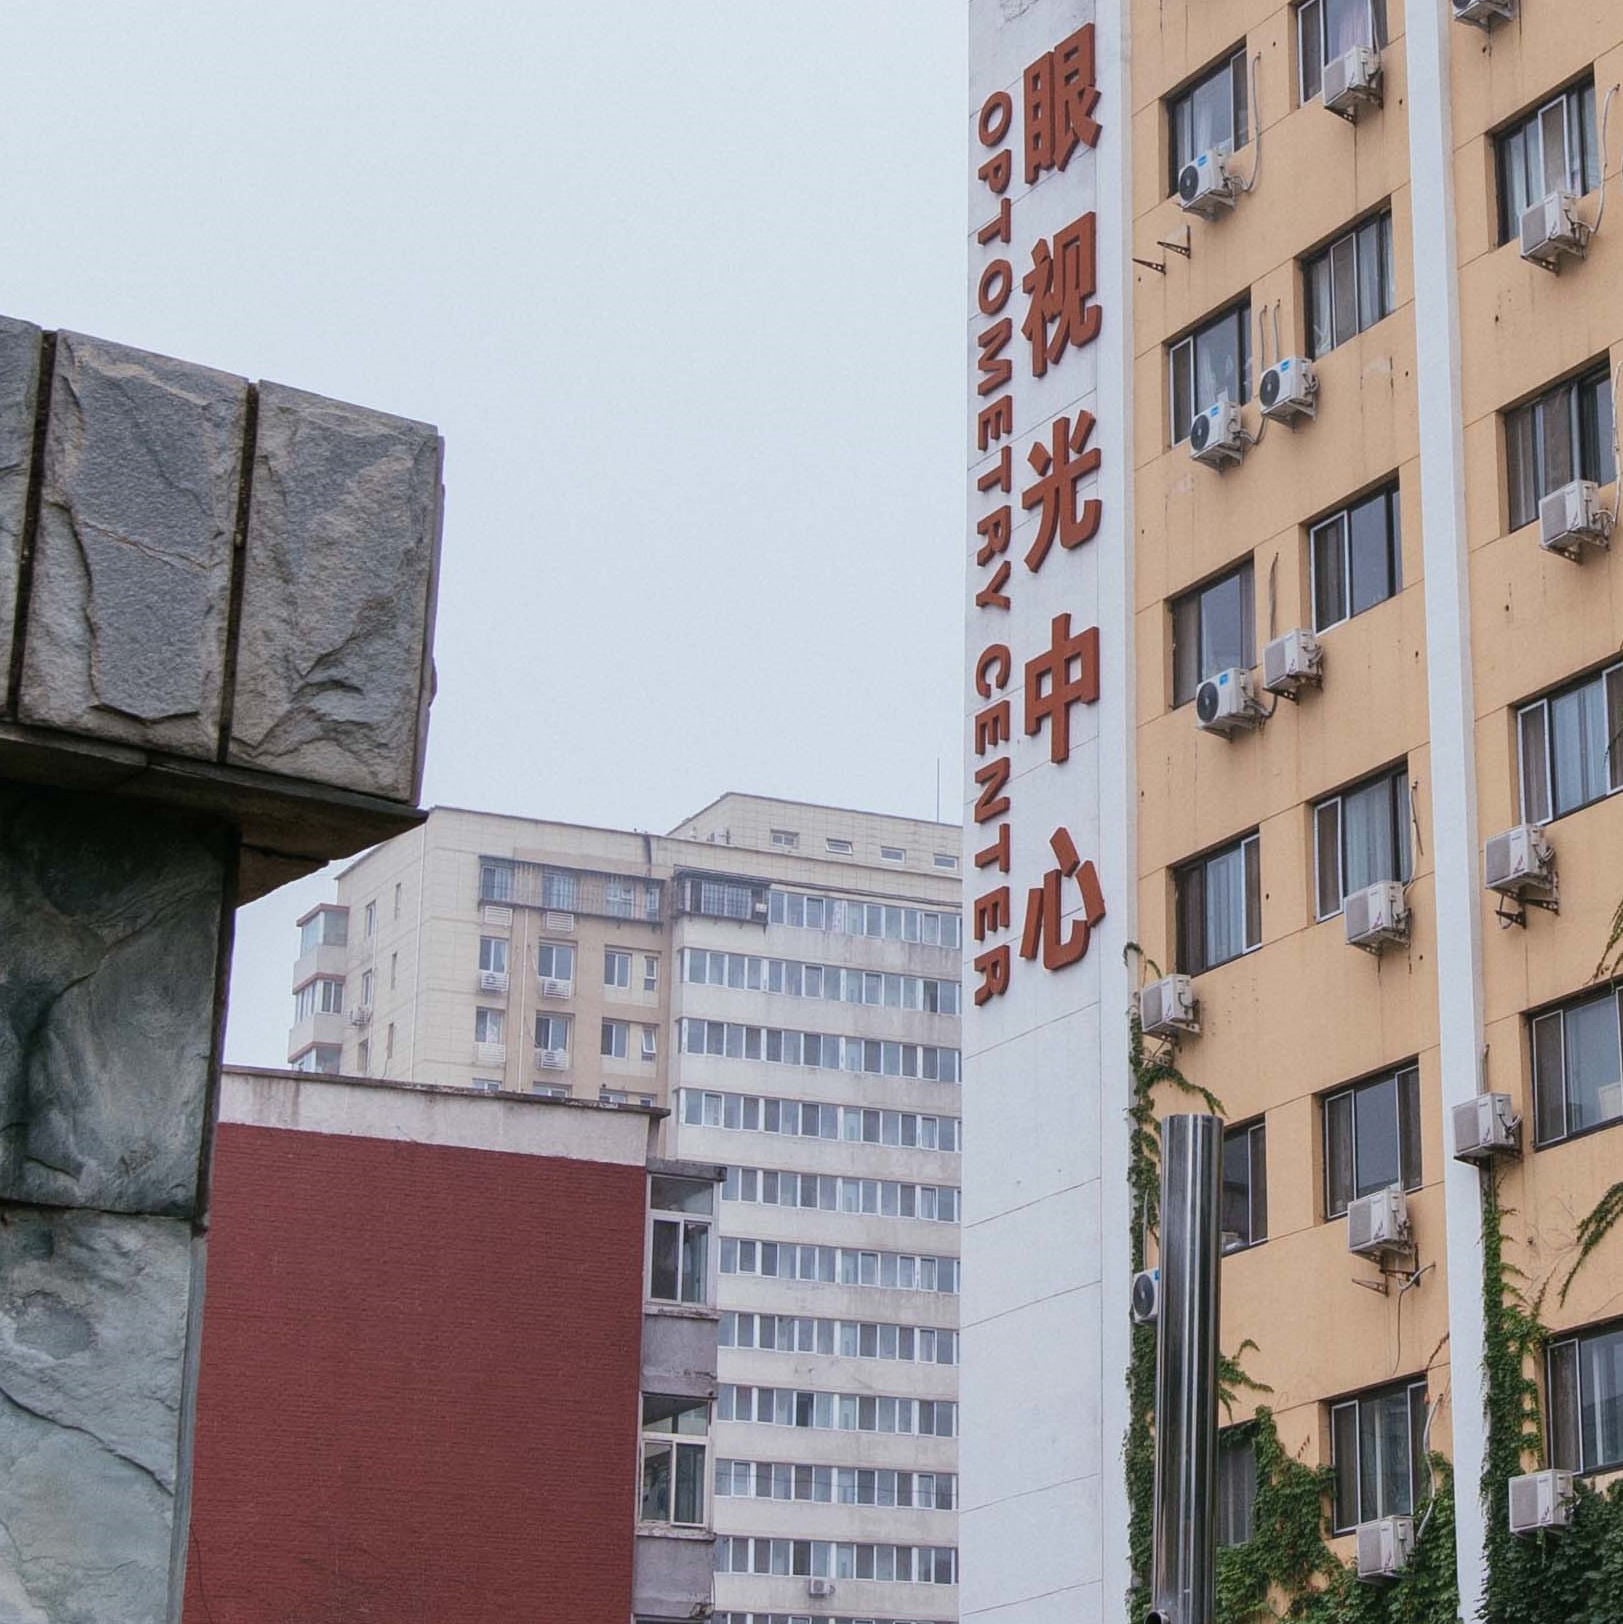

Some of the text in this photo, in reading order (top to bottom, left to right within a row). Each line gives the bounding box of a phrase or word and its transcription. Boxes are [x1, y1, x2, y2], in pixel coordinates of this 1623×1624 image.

[974, 90, 1013, 1008] OPTOMETRY CENTER
[1019, 22, 1105, 972] 眼视光中心
